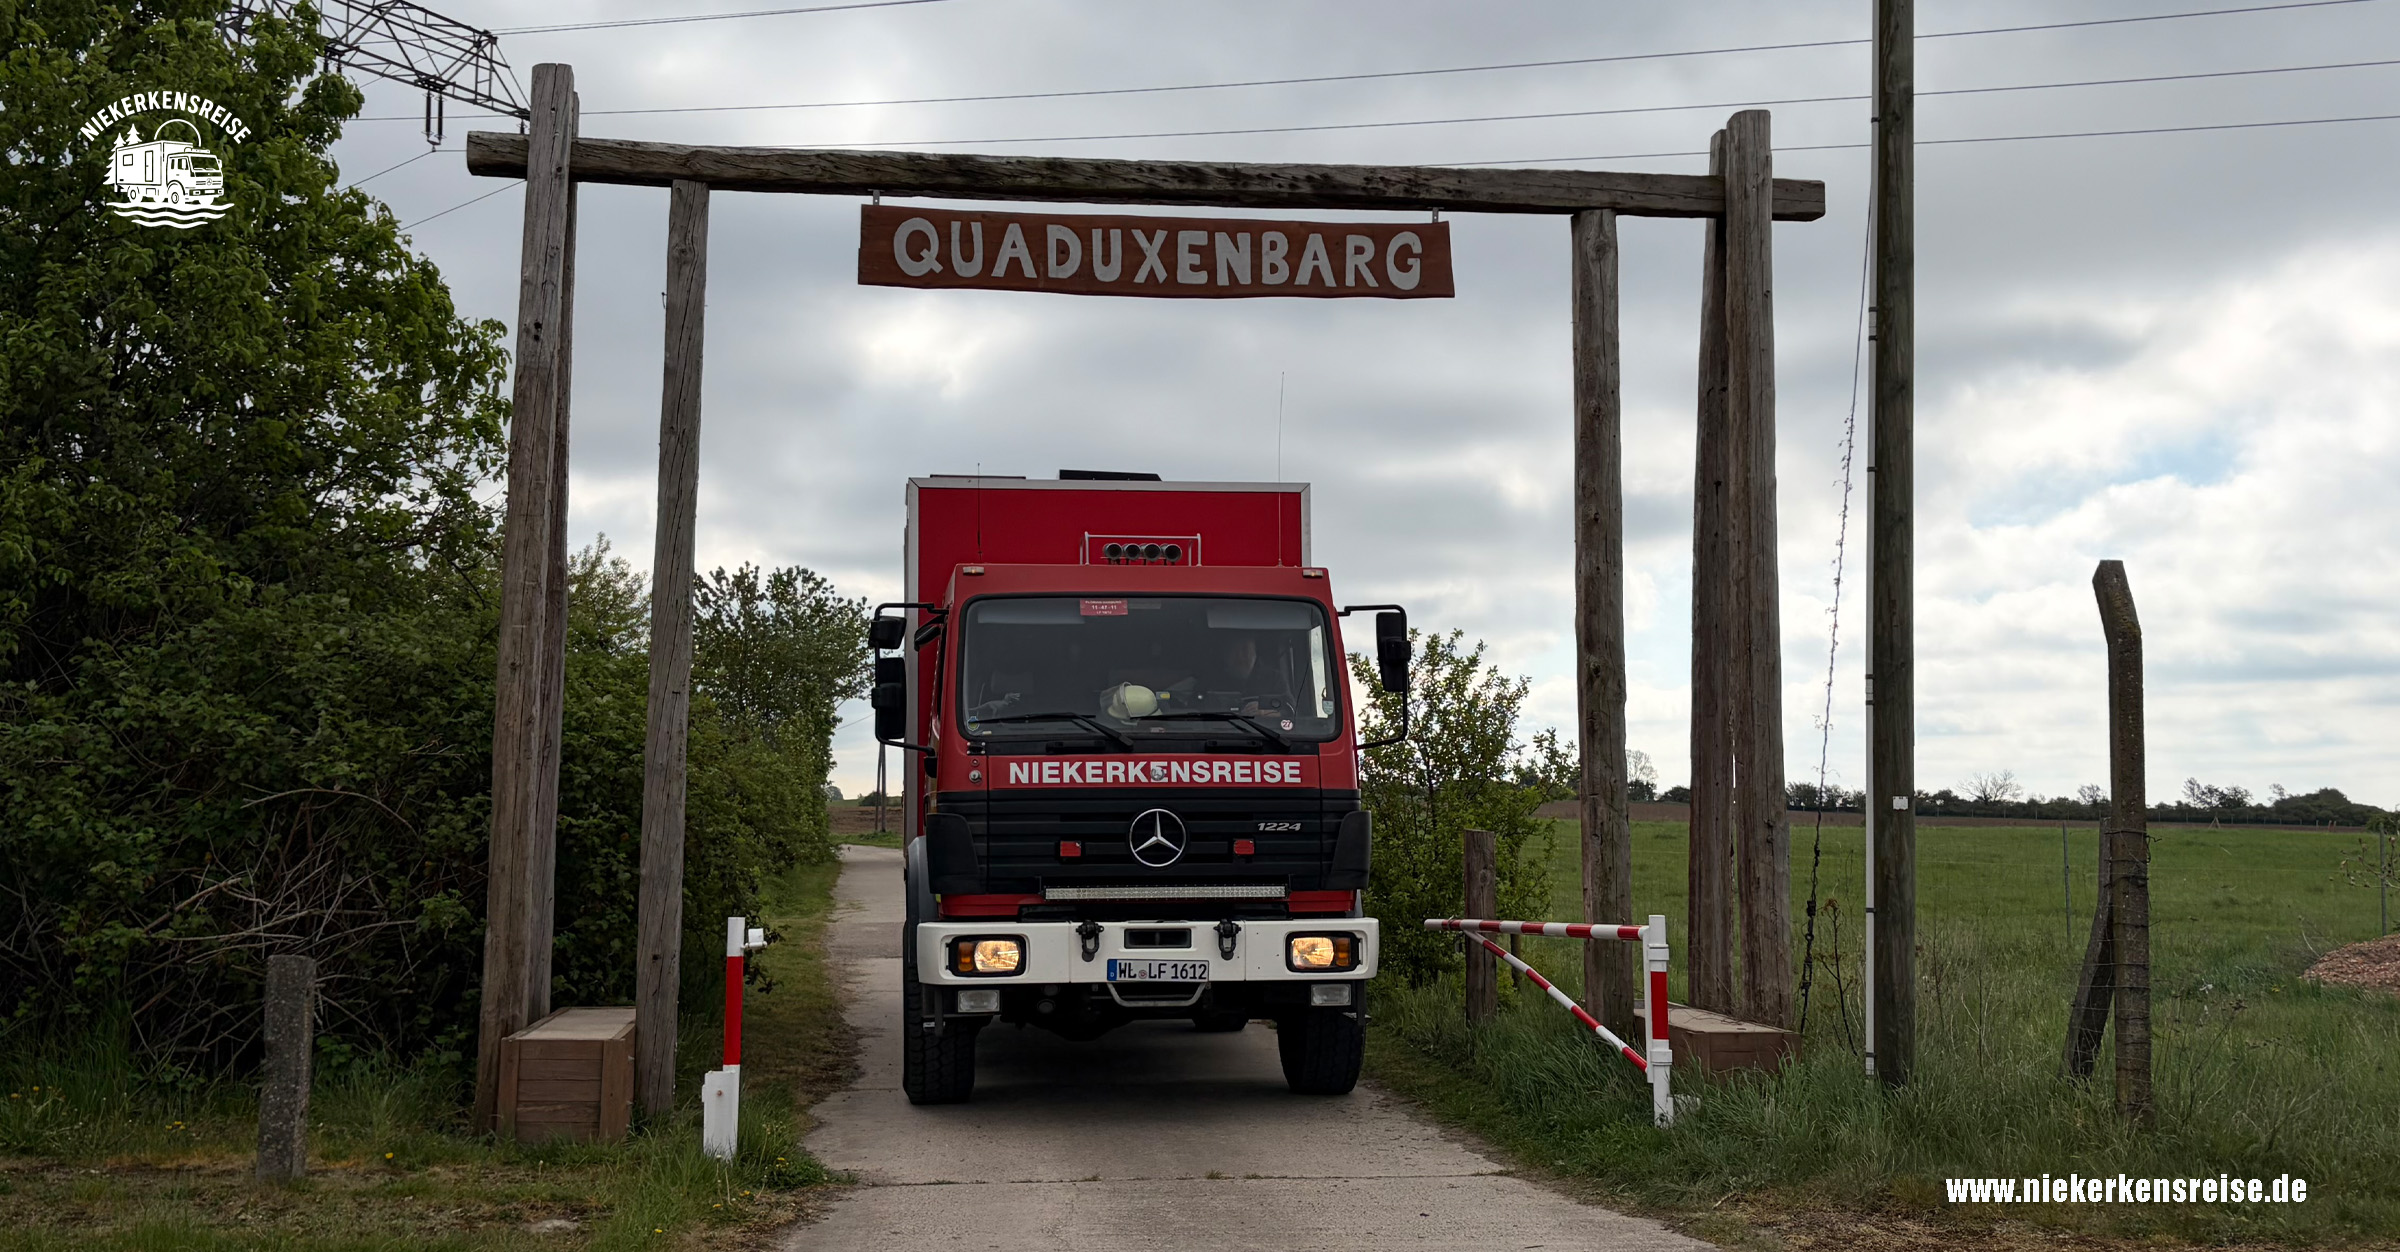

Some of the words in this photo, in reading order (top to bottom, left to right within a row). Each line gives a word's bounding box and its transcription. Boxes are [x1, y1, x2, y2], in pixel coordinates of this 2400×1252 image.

[893, 216, 1423, 291] QUADUXENBARG
[1009, 761, 1302, 784] NIEKERKENSREISE
[1257, 822, 1302, 831] 1224
[1118, 962, 1137, 979] WL
[1148, 962, 1167, 979] LF
[1170, 963, 1207, 980] 1612
